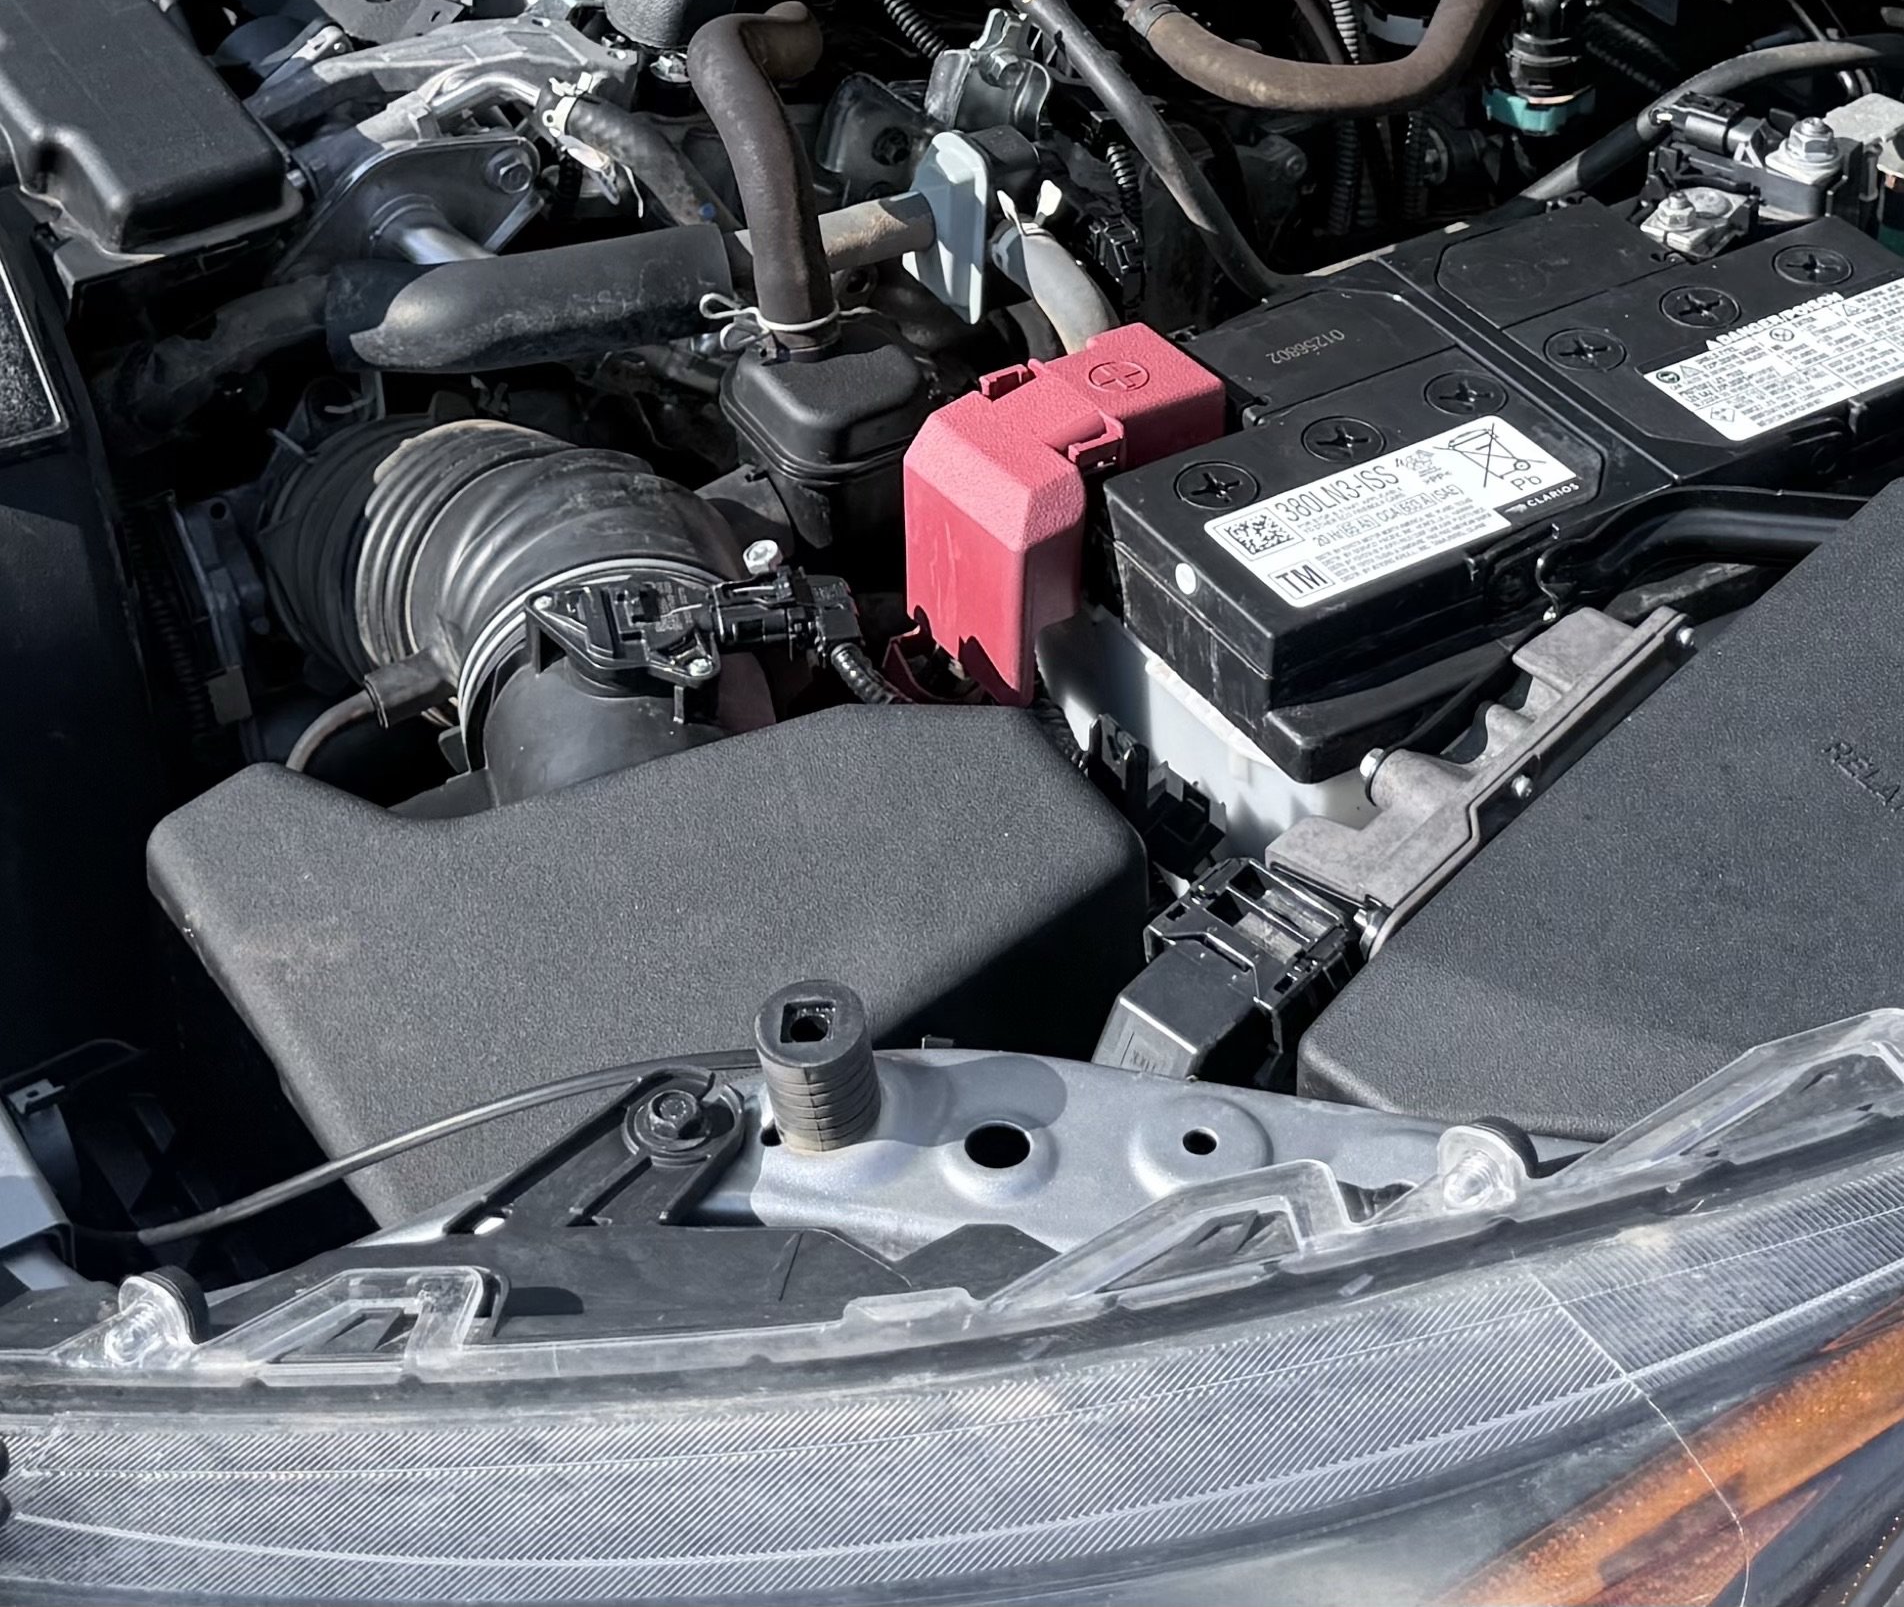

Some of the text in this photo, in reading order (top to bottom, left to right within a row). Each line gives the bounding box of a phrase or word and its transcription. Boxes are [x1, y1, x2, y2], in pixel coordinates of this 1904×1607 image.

[1274, 465, 1400, 522] 380LN3-ISS
[1510, 474, 1543, 492] Pb
[1527, 483, 1580, 508] CLARIOS
[1275, 562, 1329, 595] TM
